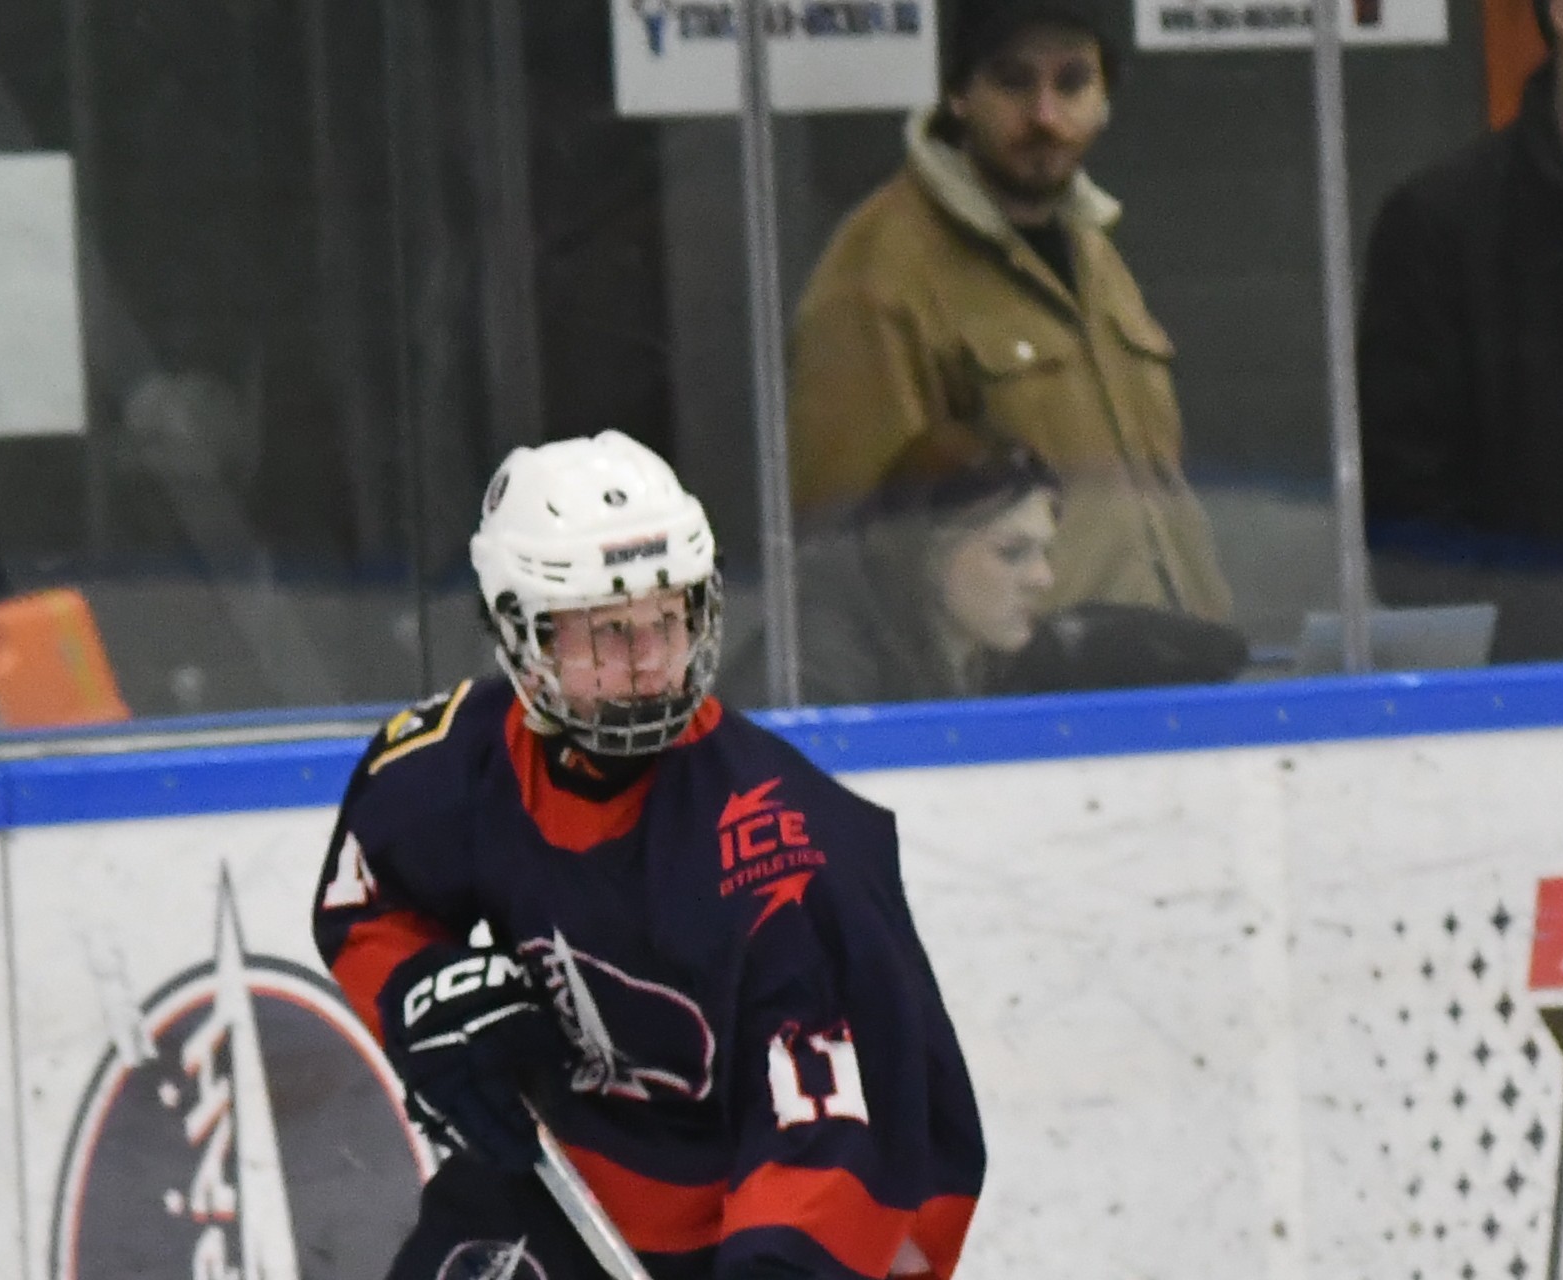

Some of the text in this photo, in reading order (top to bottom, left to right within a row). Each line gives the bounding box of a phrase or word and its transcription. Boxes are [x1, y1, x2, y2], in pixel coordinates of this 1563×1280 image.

[720, 810, 810, 872] ICE
[402, 953, 533, 1029] CCM
[767, 1018, 870, 1130] 11
